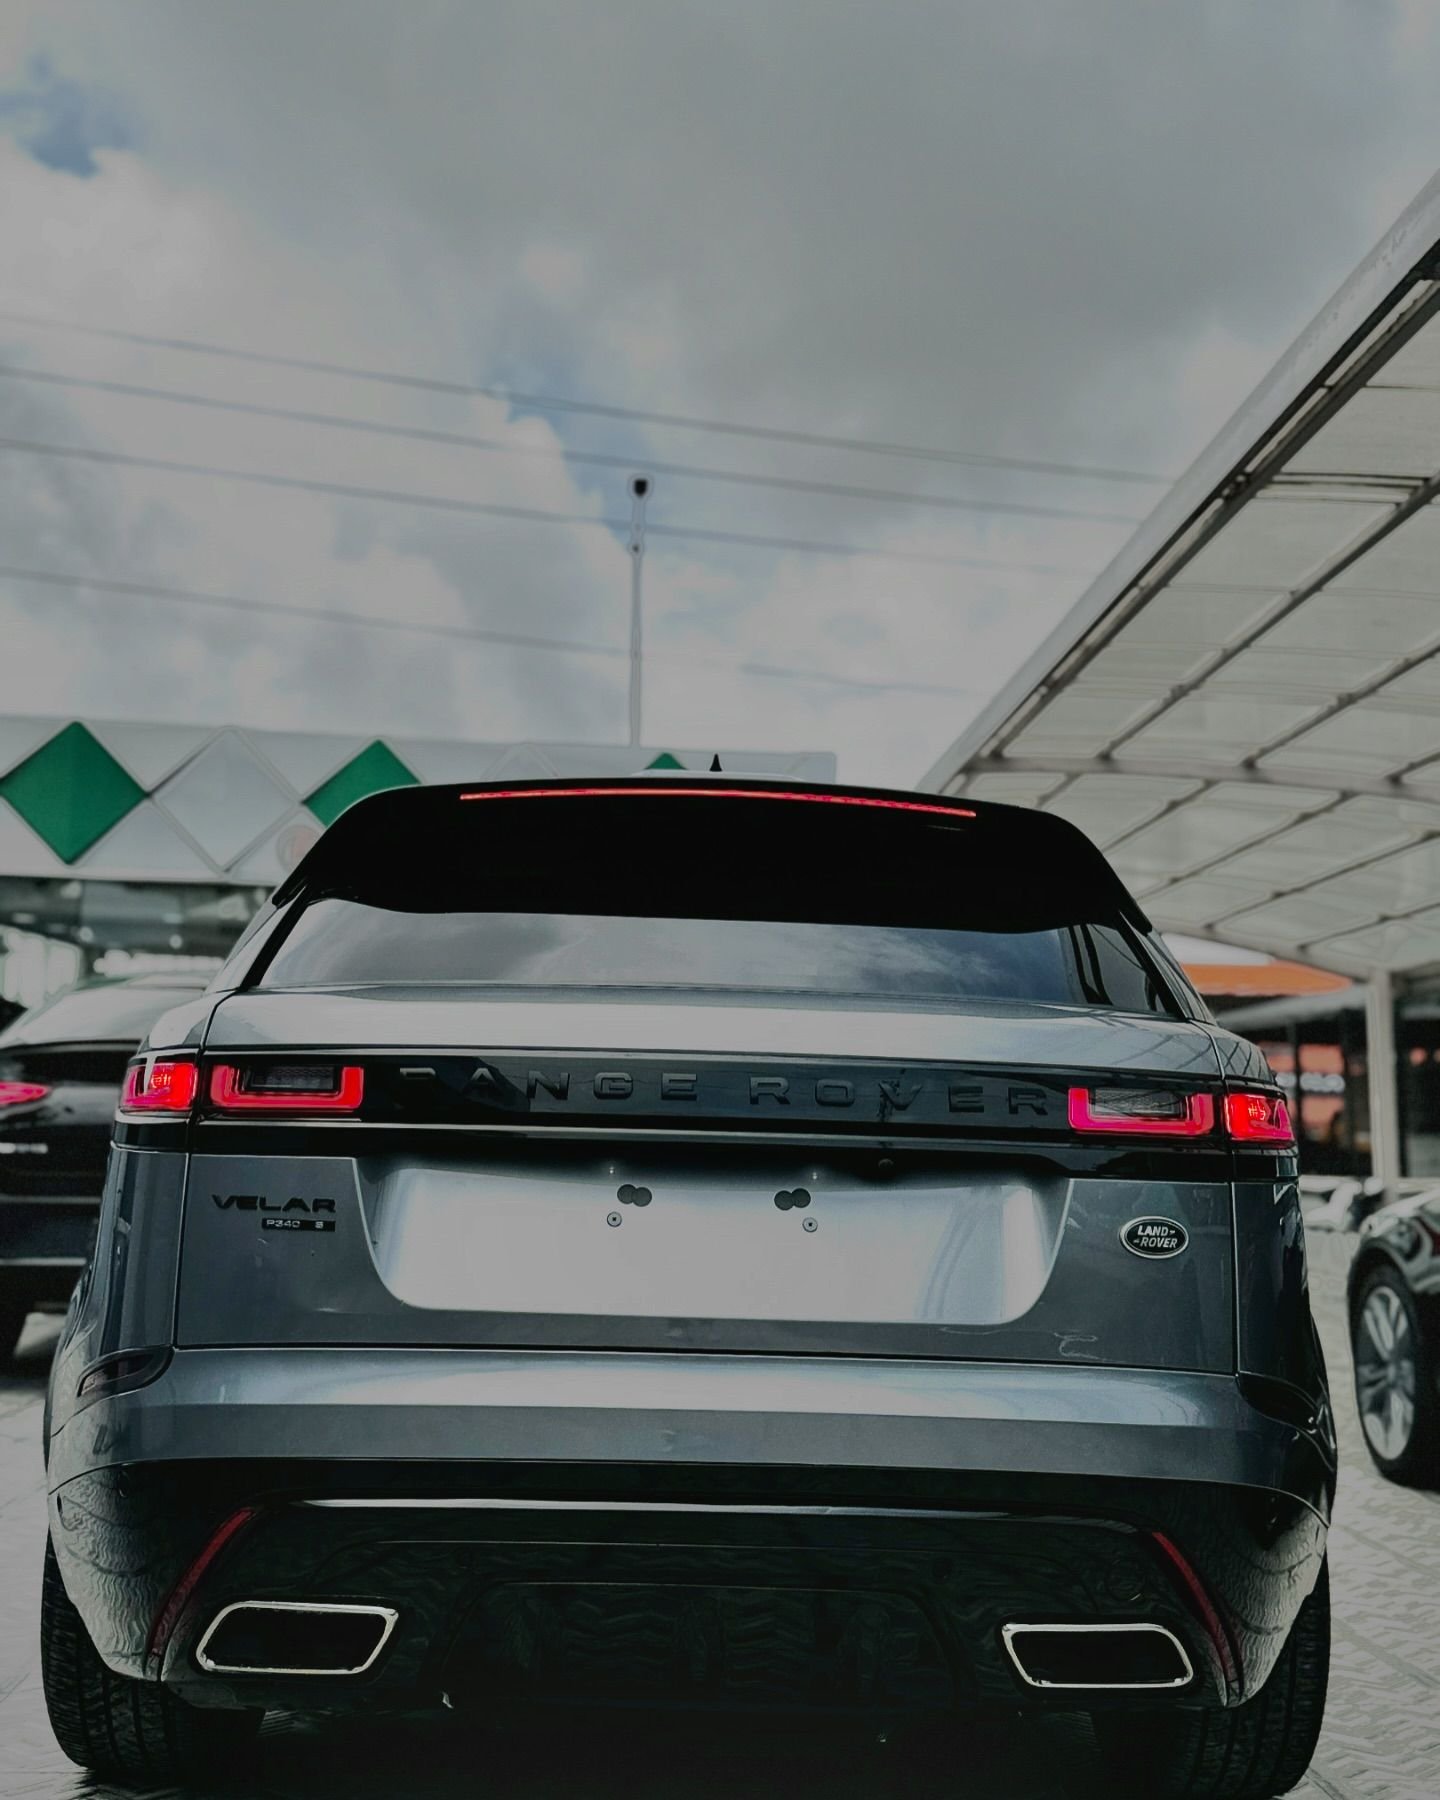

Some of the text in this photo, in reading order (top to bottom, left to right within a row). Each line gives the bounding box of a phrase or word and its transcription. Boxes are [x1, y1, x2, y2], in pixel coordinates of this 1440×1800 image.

[749, 1076, 1048, 1115] ROVER
[211, 1194, 336, 1213] VELAR
[266, 1219, 301, 1229] P340
